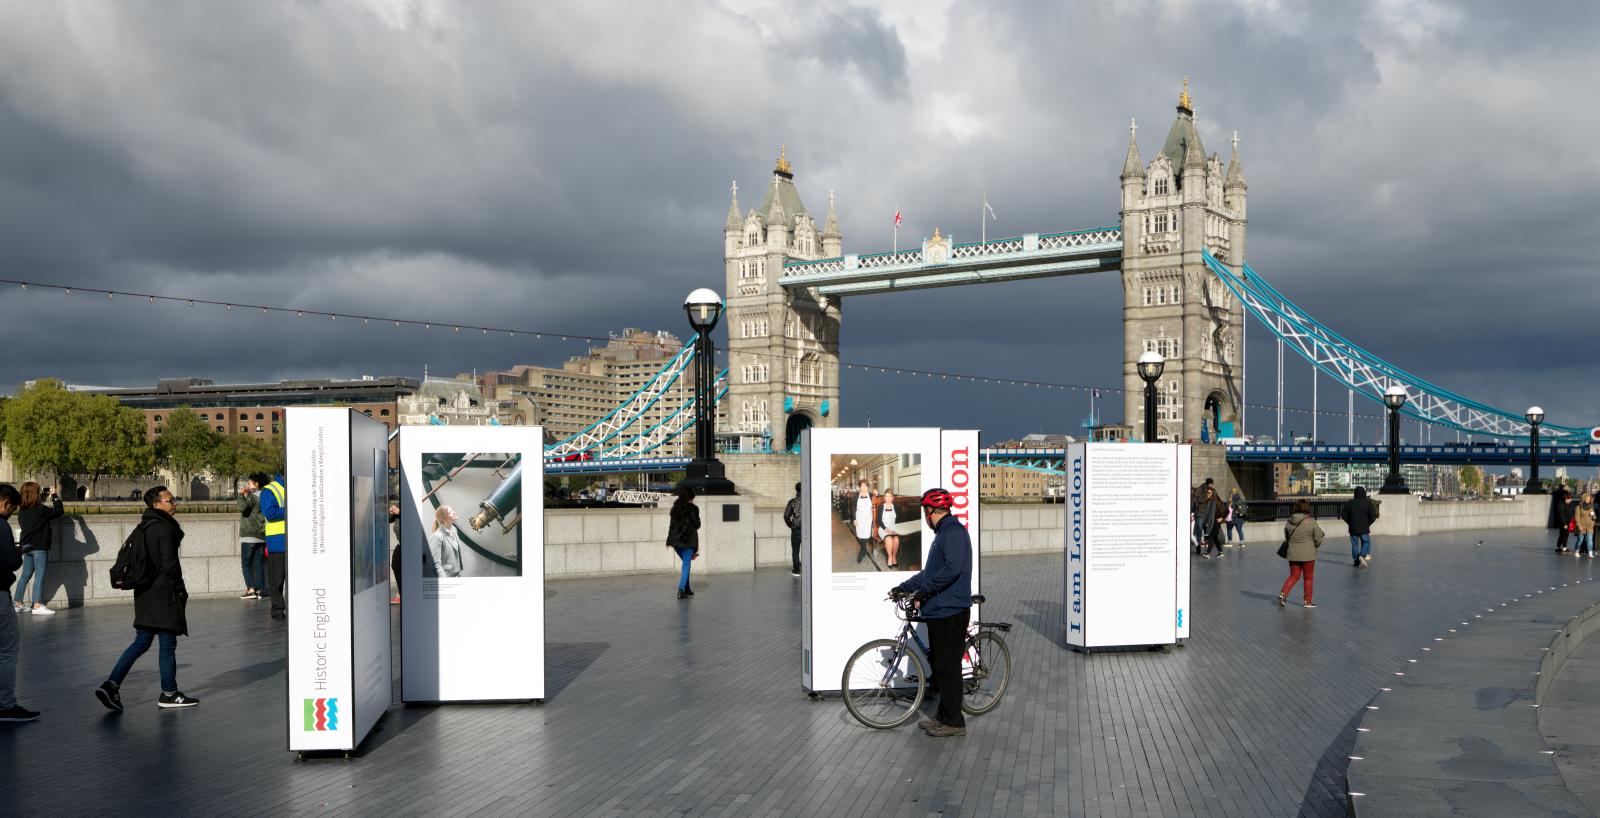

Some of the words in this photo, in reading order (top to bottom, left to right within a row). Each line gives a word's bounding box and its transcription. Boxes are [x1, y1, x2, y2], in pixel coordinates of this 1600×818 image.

[1071, 456, 1081, 562] London
[312, 588, 330, 638] England
[1073, 571, 1081, 614] am
[1071, 621, 1081, 633] I
[314, 642, 327, 690] Historic
